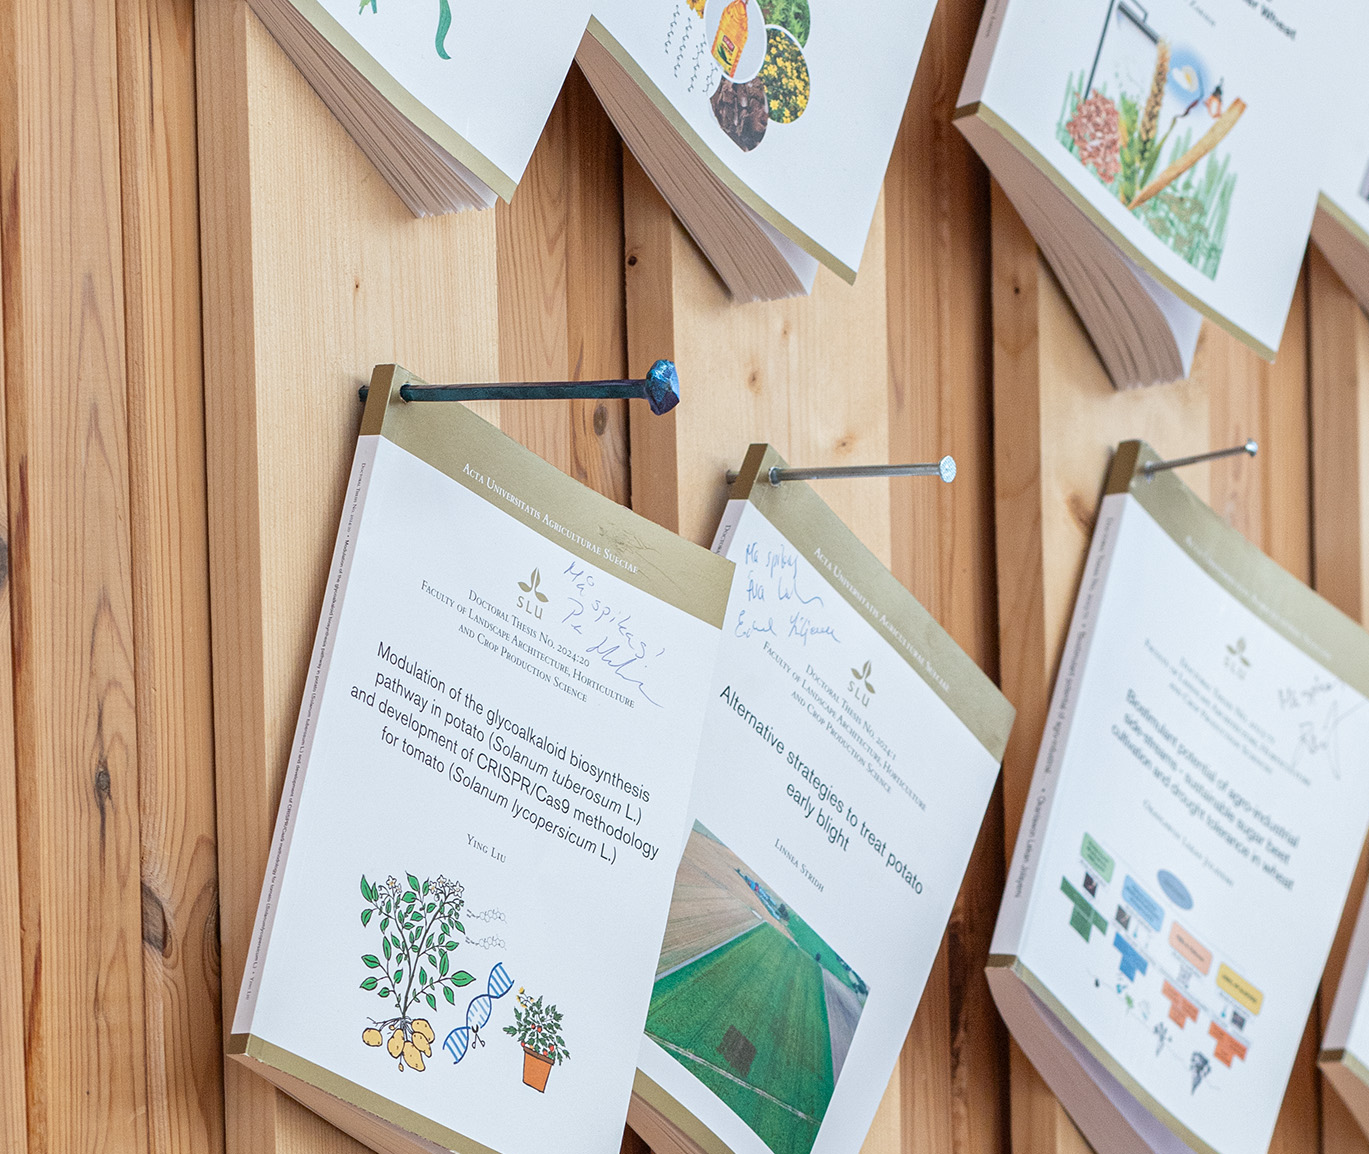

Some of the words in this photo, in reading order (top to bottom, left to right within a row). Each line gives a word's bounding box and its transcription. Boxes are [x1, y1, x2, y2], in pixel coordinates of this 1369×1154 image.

[516, 595, 543, 620] SLU
[374, 672, 429, 713] pathway
[430, 698, 442, 718] in
[443, 711, 485, 742] potato
[488, 731, 549, 777] (Solanum
[551, 769, 622, 814] tuberosum
[625, 803, 642, 826] L.)
[377, 640, 446, 693] Modulation
[448, 687, 463, 702] of
[464, 693, 483, 715] the
[486, 708, 567, 761] glycoalkaloid
[569, 749, 650, 803] biosynthesis
[847, 680, 870, 708] SLU
[350, 685, 376, 707] and
[378, 700, 458, 755] development
[460, 747, 475, 762] of
[476, 752, 570, 814] CRISPR/Cas9
[573, 808, 659, 860] methodology
[381, 725, 399, 747] for
[401, 738, 445, 773] tomato
[448, 762, 509, 808] (Solanum
[511, 798, 597, 854] lycopersicum
[600, 842, 616, 865] L.)
[719, 685, 785, 754] Alternative
[786, 751, 844, 813] strategies
[845, 806, 858, 827] to
[859, 821, 886, 857] treat
[885, 852, 923, 895] potato
[786, 783, 815, 819] early
[815, 807, 849, 852] blight
